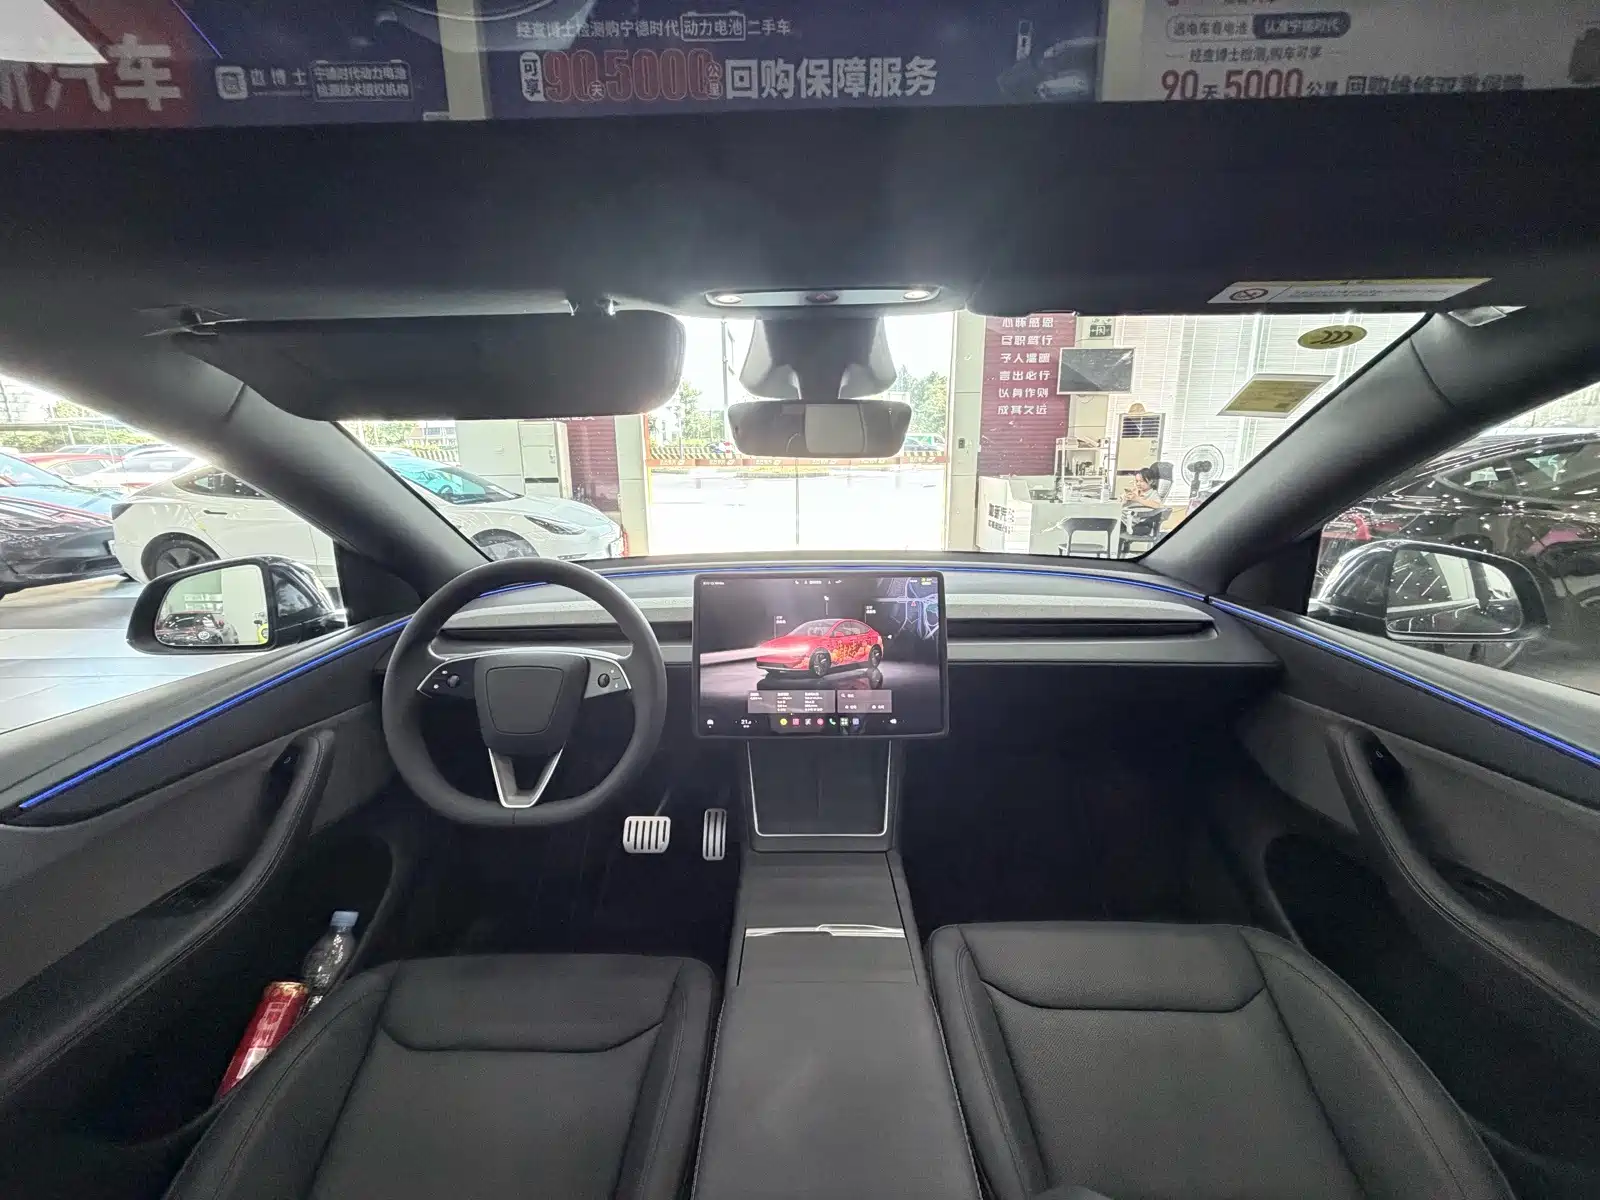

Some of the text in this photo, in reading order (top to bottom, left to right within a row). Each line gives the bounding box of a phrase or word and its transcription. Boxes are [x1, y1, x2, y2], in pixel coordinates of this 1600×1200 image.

[522, 56, 541, 97] 可享
[724, 55, 940, 100] 回购保障服务
[999, 370, 1051, 381] 言出必行
[998, 387, 1049, 398] 以身作则
